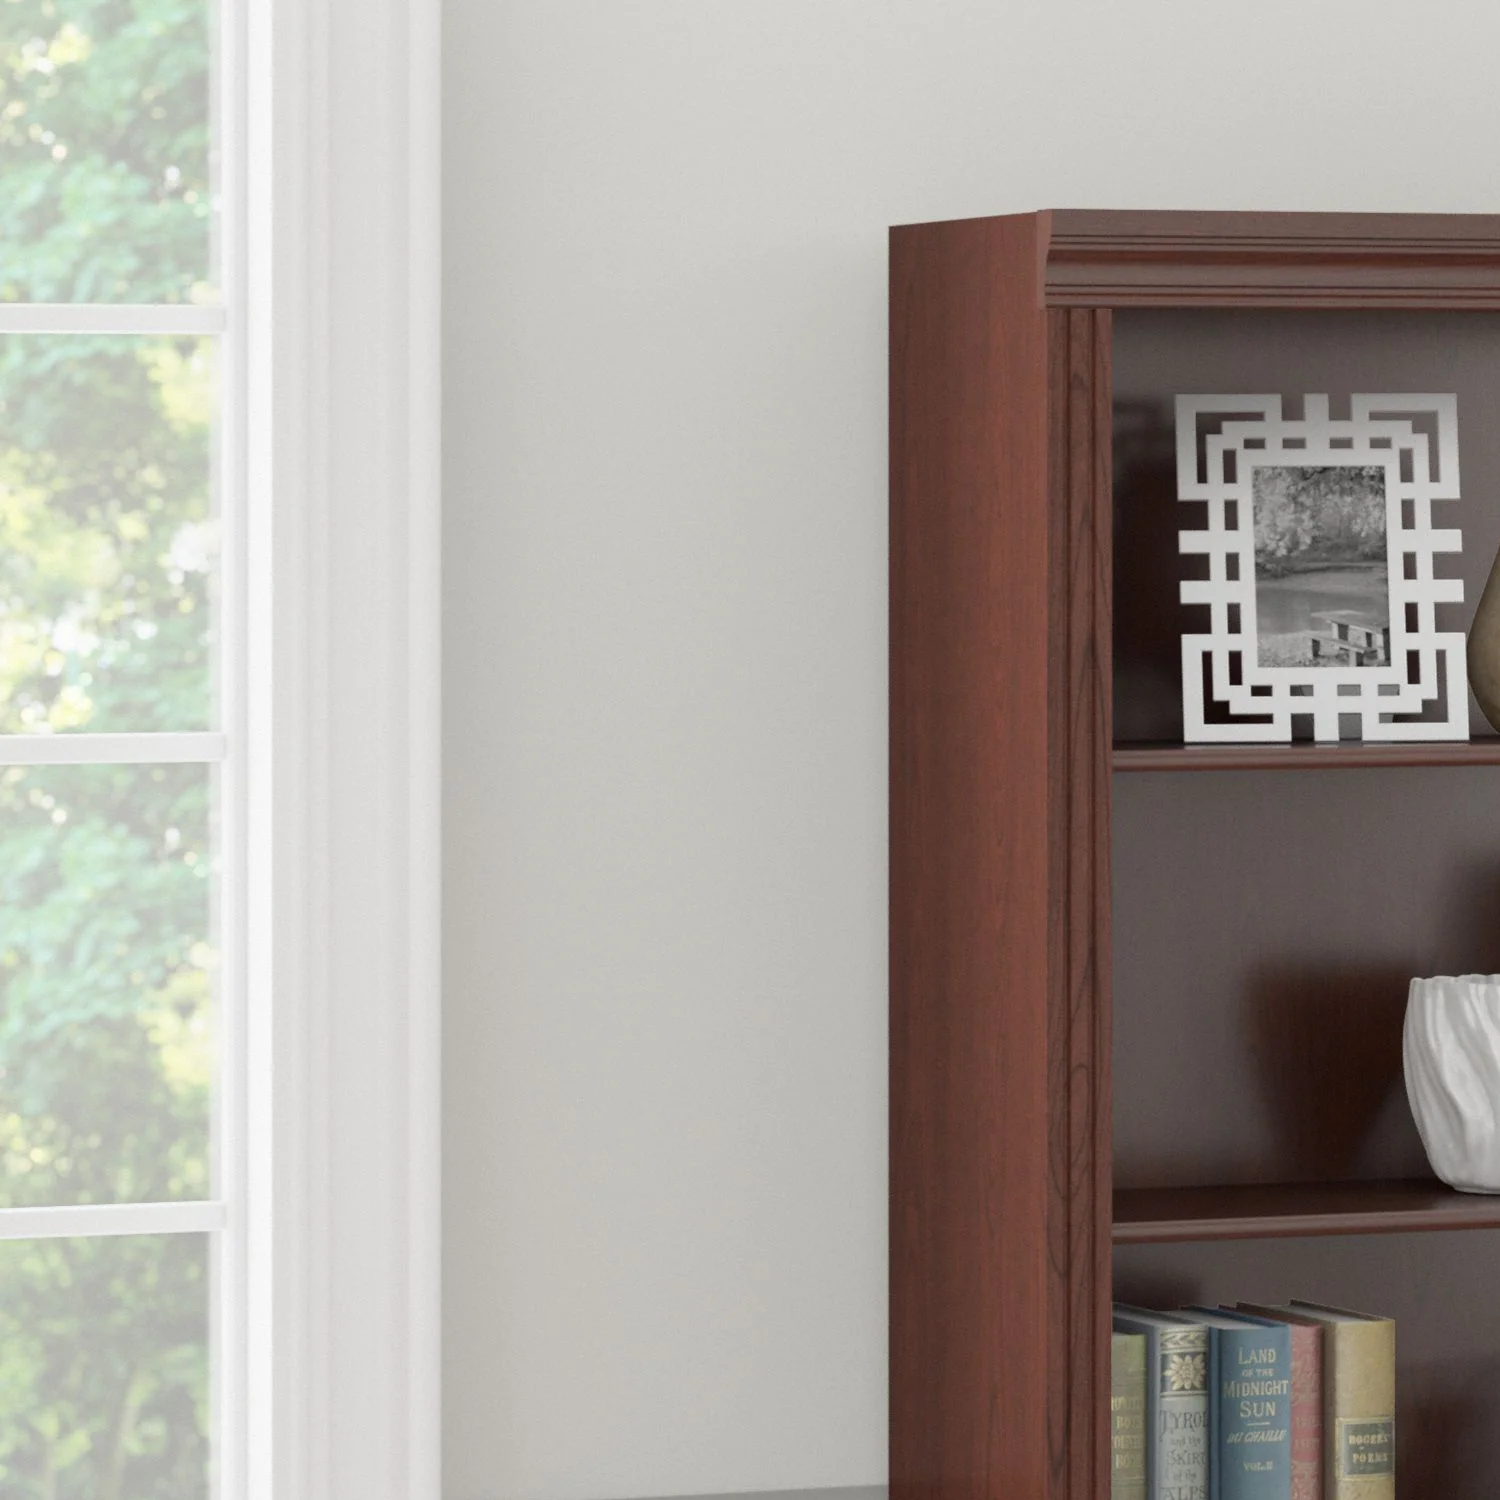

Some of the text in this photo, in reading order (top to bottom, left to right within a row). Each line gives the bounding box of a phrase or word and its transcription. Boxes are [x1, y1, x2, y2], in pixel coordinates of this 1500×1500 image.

[1238, 1346, 1277, 1365] LAND
[1255, 1367, 1275, 1377] THE
[1222, 1379, 1289, 1398] MIDNIGHT
[1239, 1400, 1276, 1418] SUN
